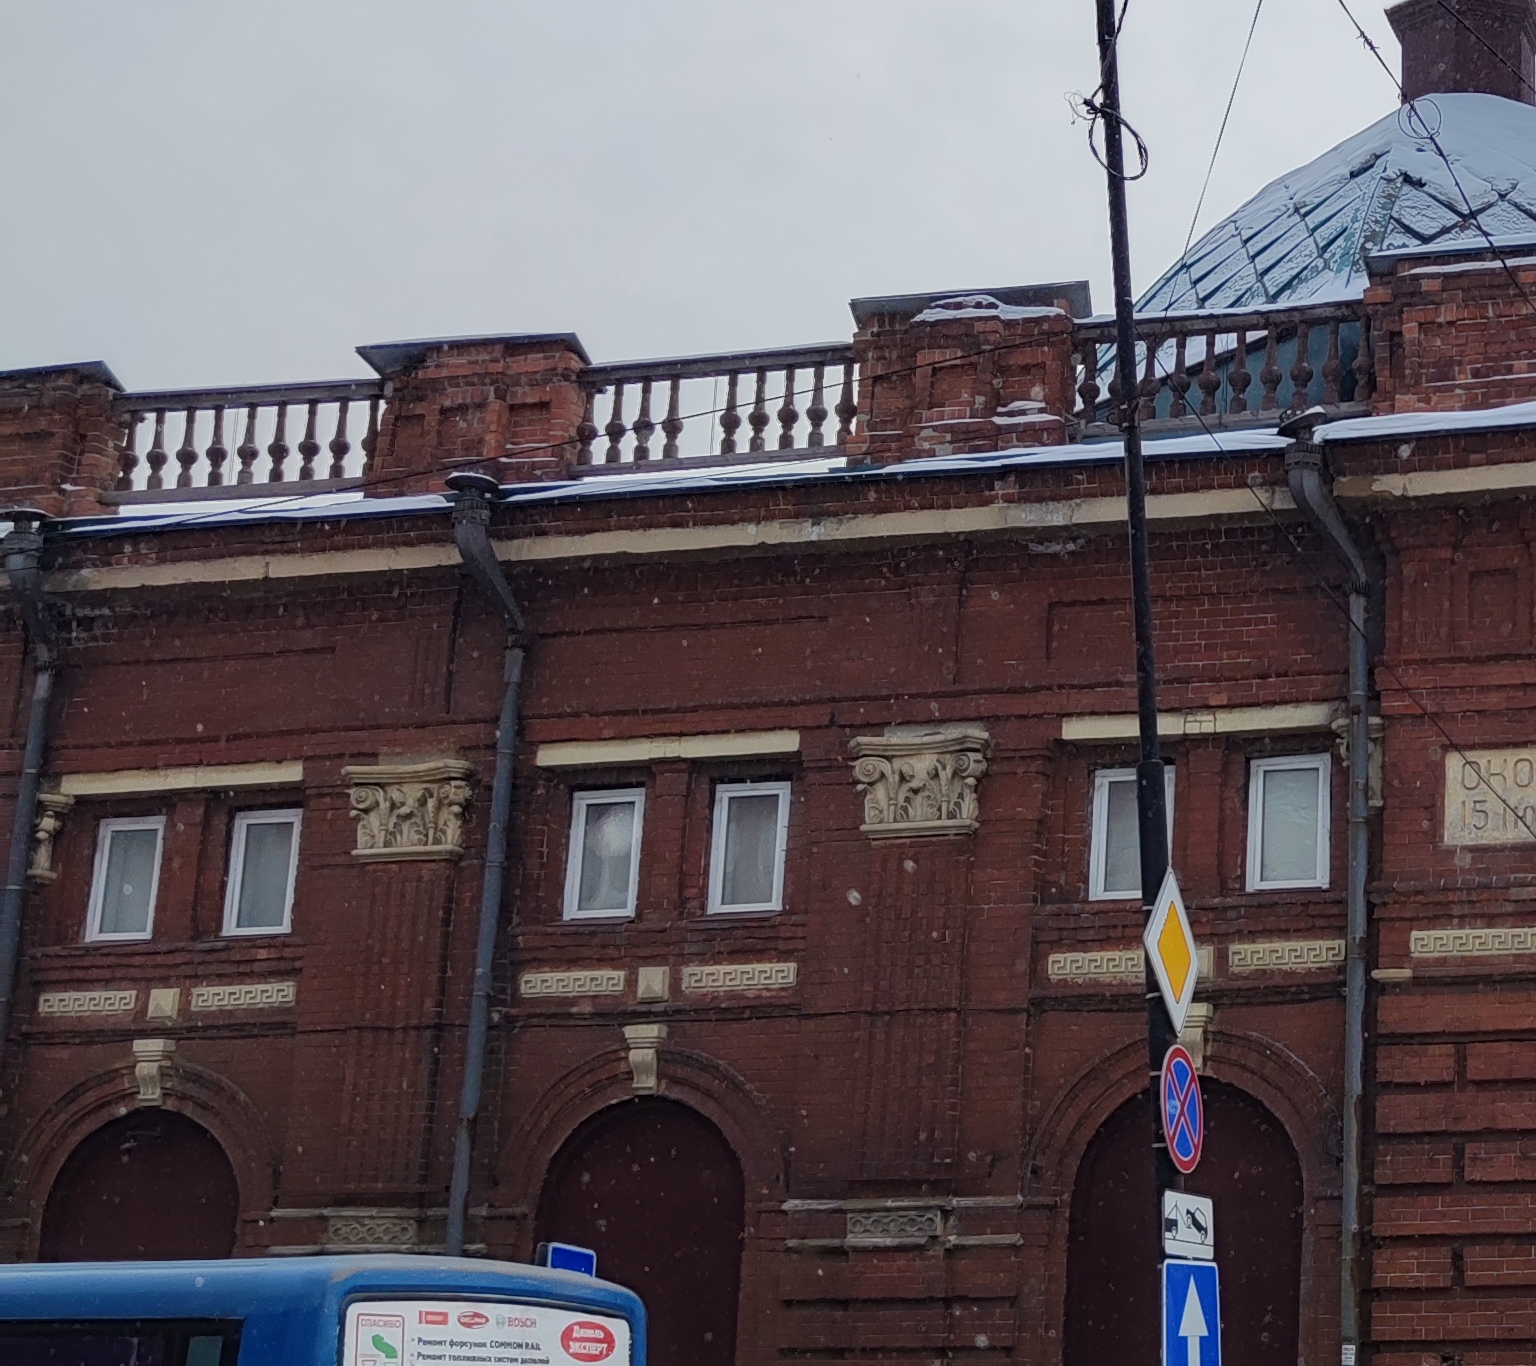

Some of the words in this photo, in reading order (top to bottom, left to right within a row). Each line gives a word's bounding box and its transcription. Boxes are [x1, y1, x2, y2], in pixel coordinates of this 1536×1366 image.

[1460, 799, 1489, 832] 15
[507, 1317, 537, 1328] BOSCH
[417, 1337, 448, 1347] Ремонт
[489, 1340, 524, 1350] COMMON
[416, 1351, 447, 1361] Ремонт
